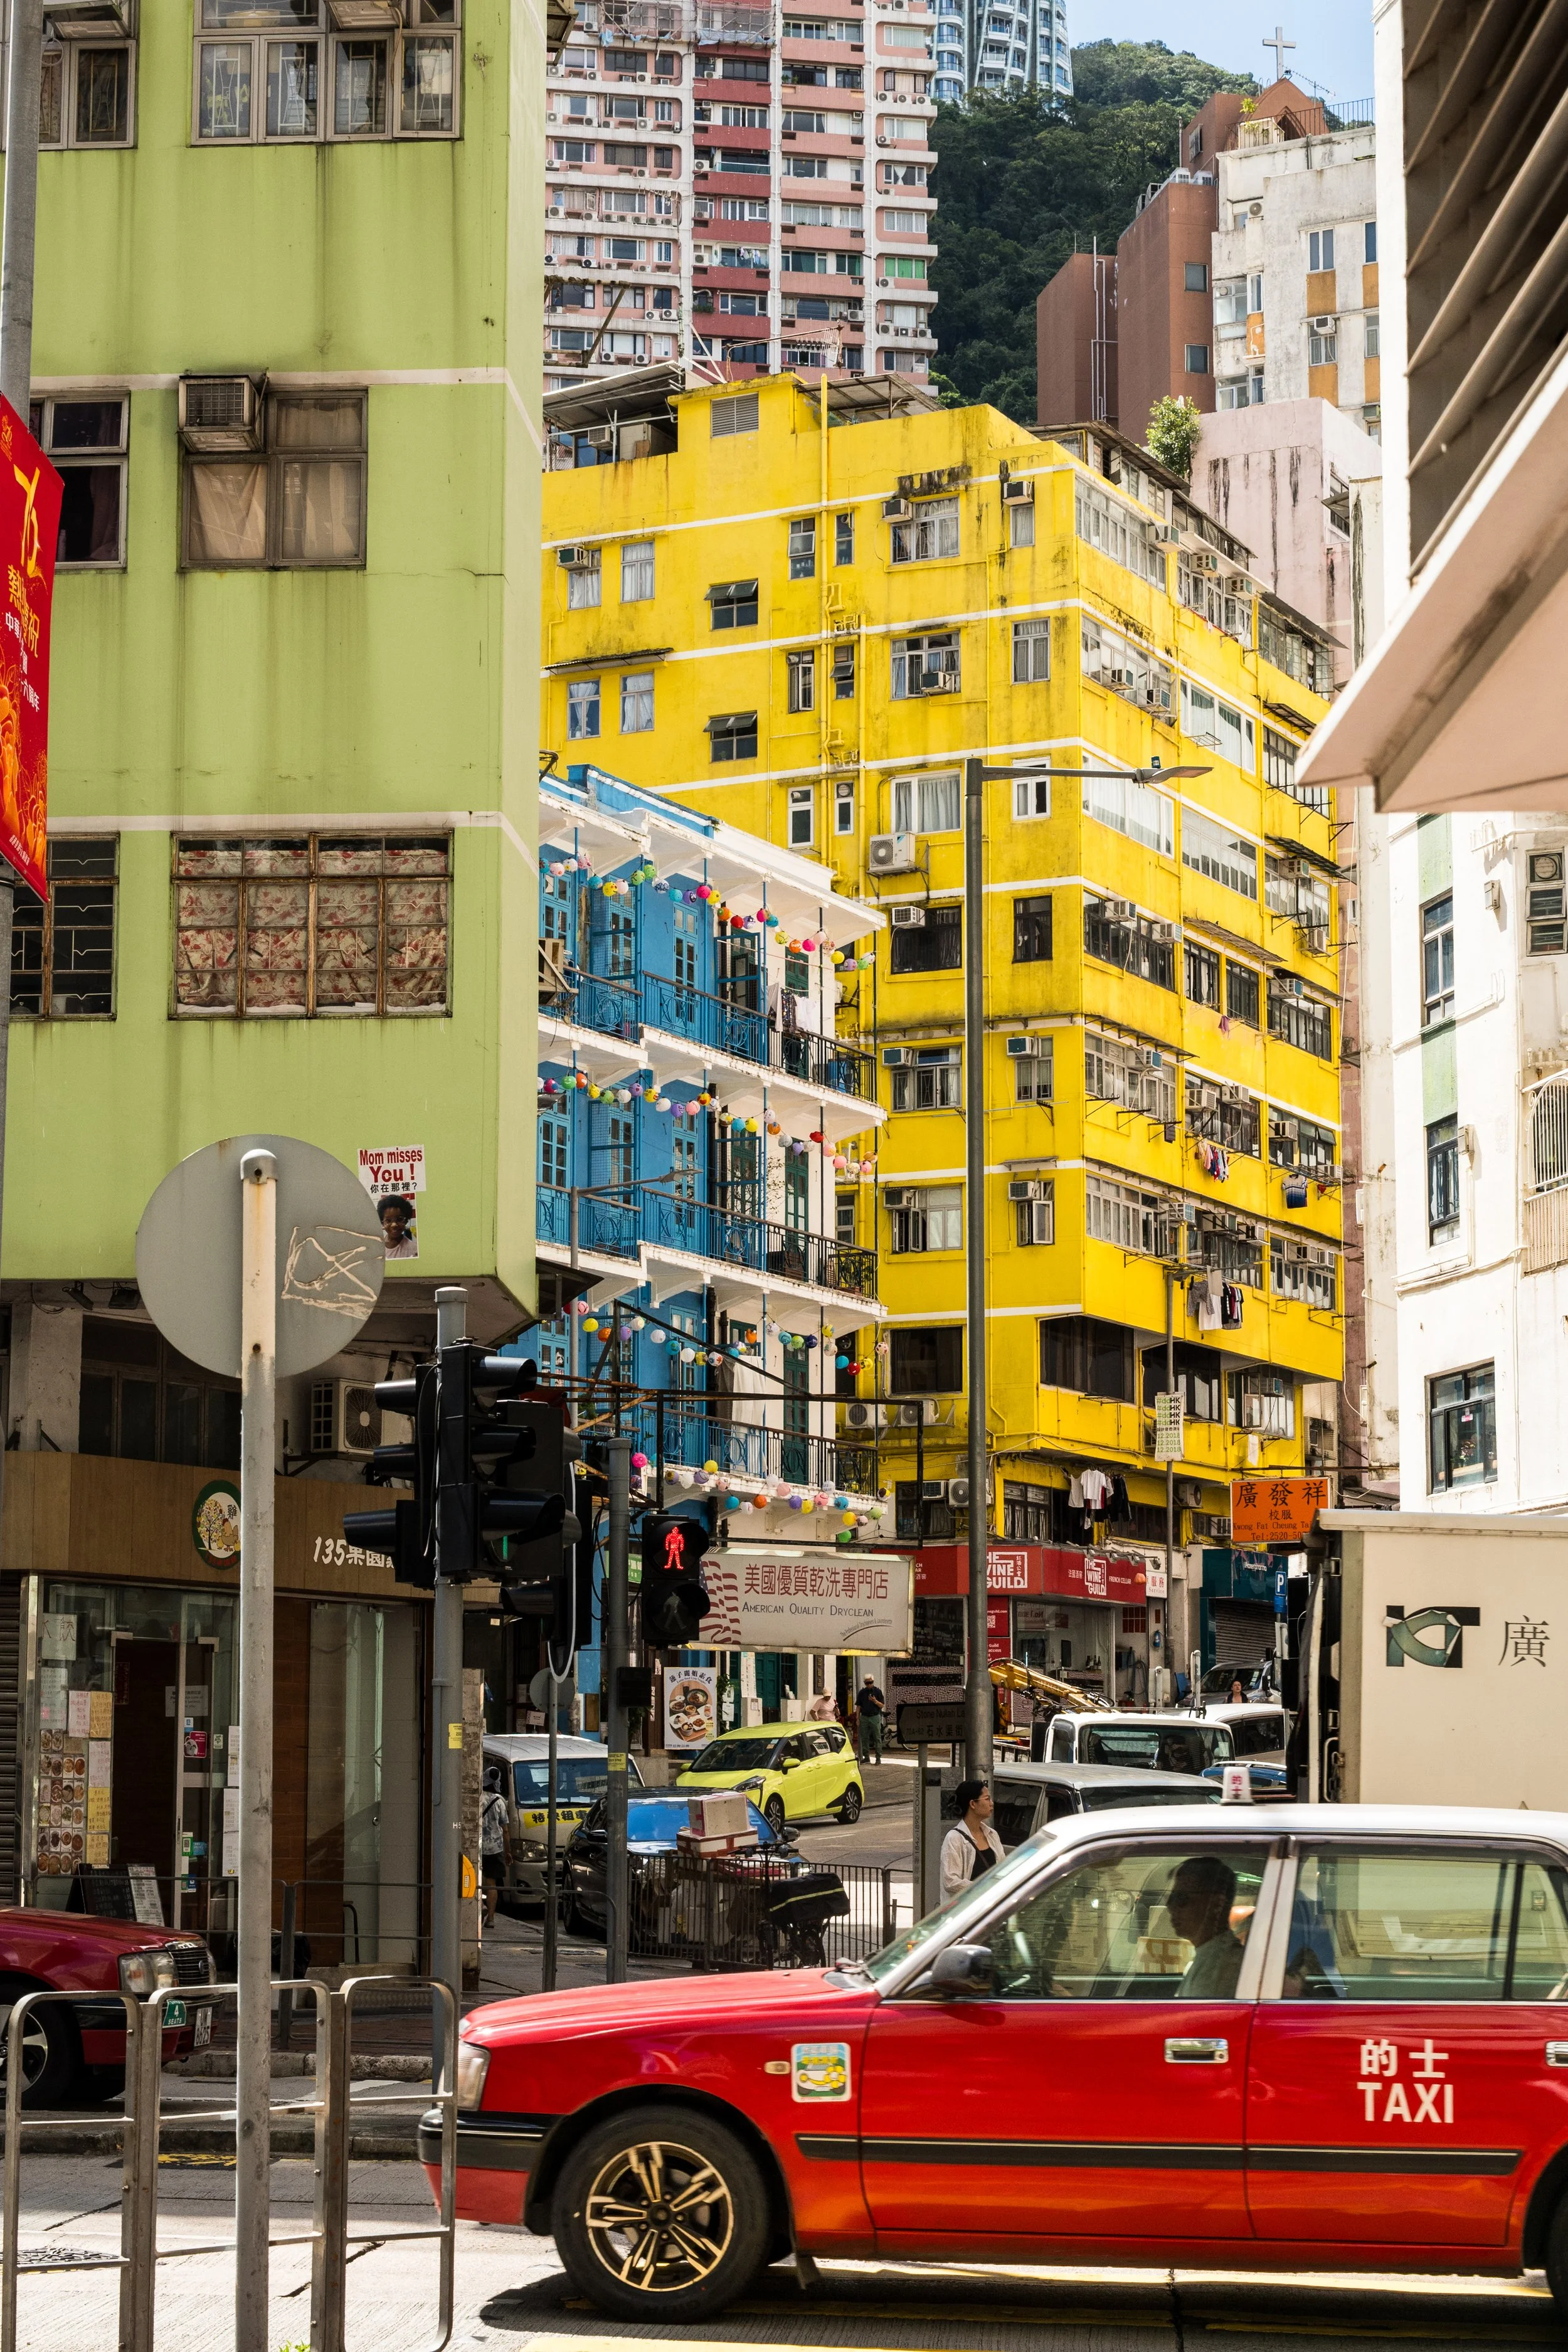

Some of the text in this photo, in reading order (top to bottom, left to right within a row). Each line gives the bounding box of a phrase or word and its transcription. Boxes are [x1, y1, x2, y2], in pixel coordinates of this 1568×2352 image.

[359, 1147, 423, 1166] Mom misses
[369, 1165, 404, 1184] You
[1236, 1480, 1327, 1508] 廣發祥
[1269, 1509, 1293, 1521] 校服
[1233, 1522, 1253, 1531] Kwong
[1256, 1522, 1268, 1530] Fat
[1272, 1522, 1297, 1530] Cheung
[1251, 1531, 1309, 1541] Tel:2520-50
[987, 1552, 1000, 1563] HE
[1086, 1559, 1096, 1570] THE
[744, 1563, 889, 1600] 美國優質乾洗專門店
[1087, 1570, 1101, 1583] WINE
[1108, 1576, 1120, 1584] FRENCH
[1277, 1574, 1285, 1592] P
[1088, 1583, 1105, 1596] GUILD
[742, 1601, 874, 1617] AMERICAN QUALITY DRYCLEAN
[1498, 1614, 1550, 1668] 廣
[916, 1707, 965, 1719] Stone Nullah La
[926, 1725, 963, 1737] 石水渠街
[174, 2005, 179, 2017] 4
[167, 2017, 183, 2025] SEATS
[1360, 2038, 1449, 2079] 的士
[1357, 2082, 1454, 2124] TAXI
